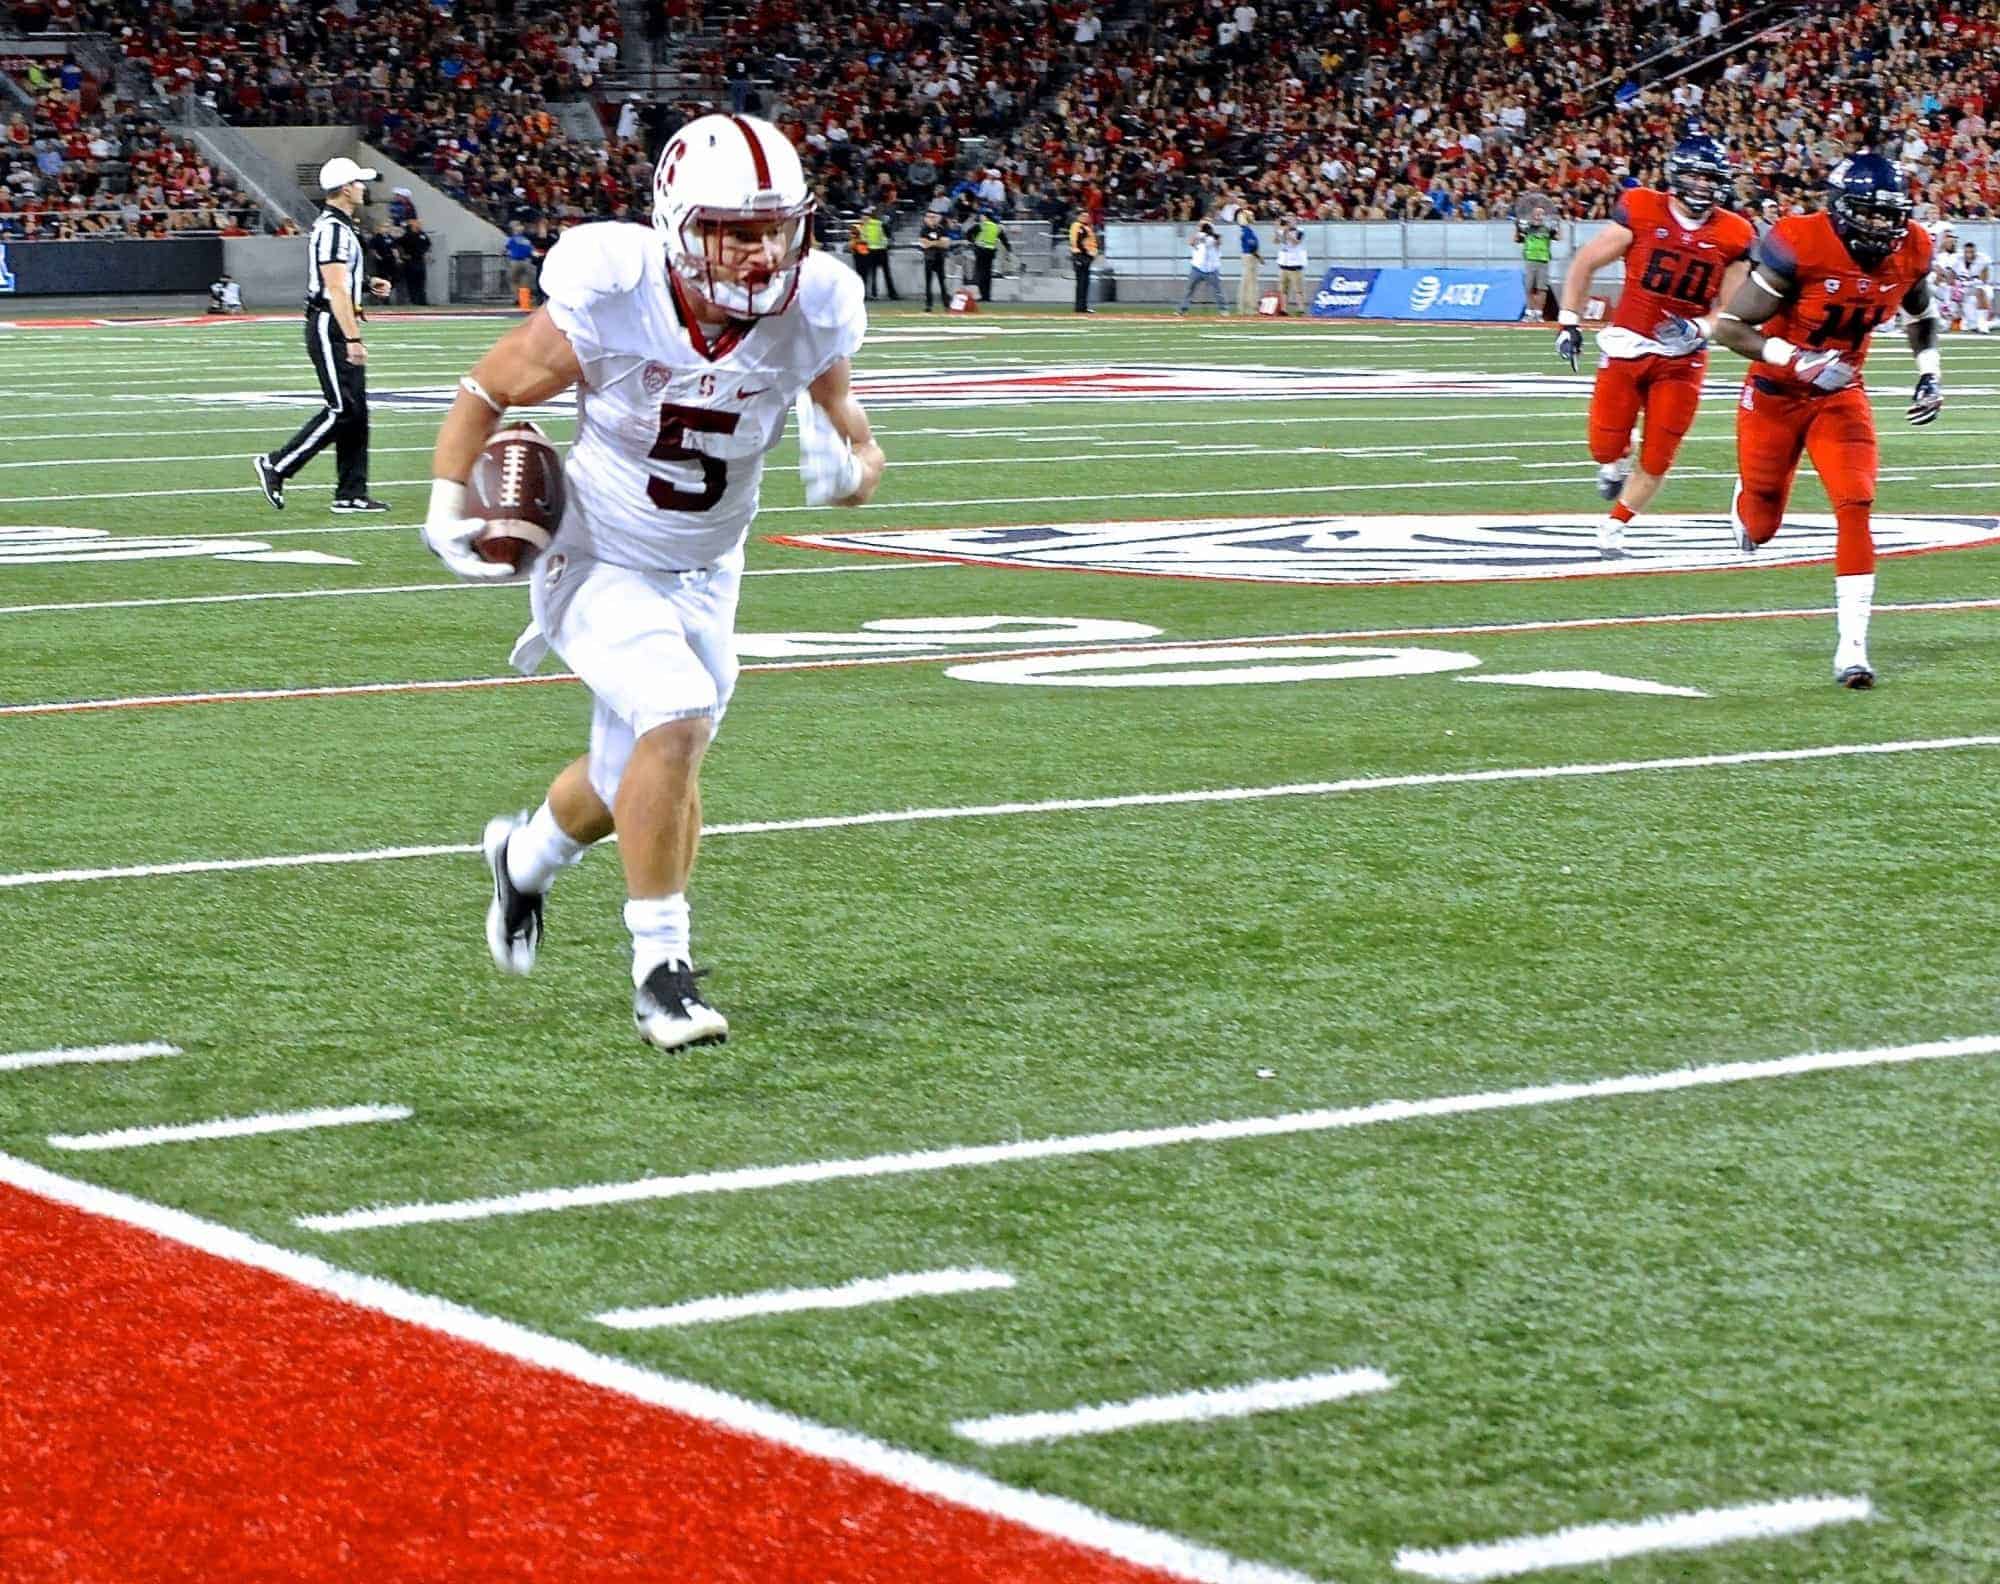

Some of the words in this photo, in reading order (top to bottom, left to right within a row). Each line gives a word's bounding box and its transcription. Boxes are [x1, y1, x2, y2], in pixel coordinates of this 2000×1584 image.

[1436, 283, 1489, 305] AT&T
[1641, 248, 1714, 305] 60
[1806, 304, 1888, 352] 14
[646, 402, 742, 512] 5
